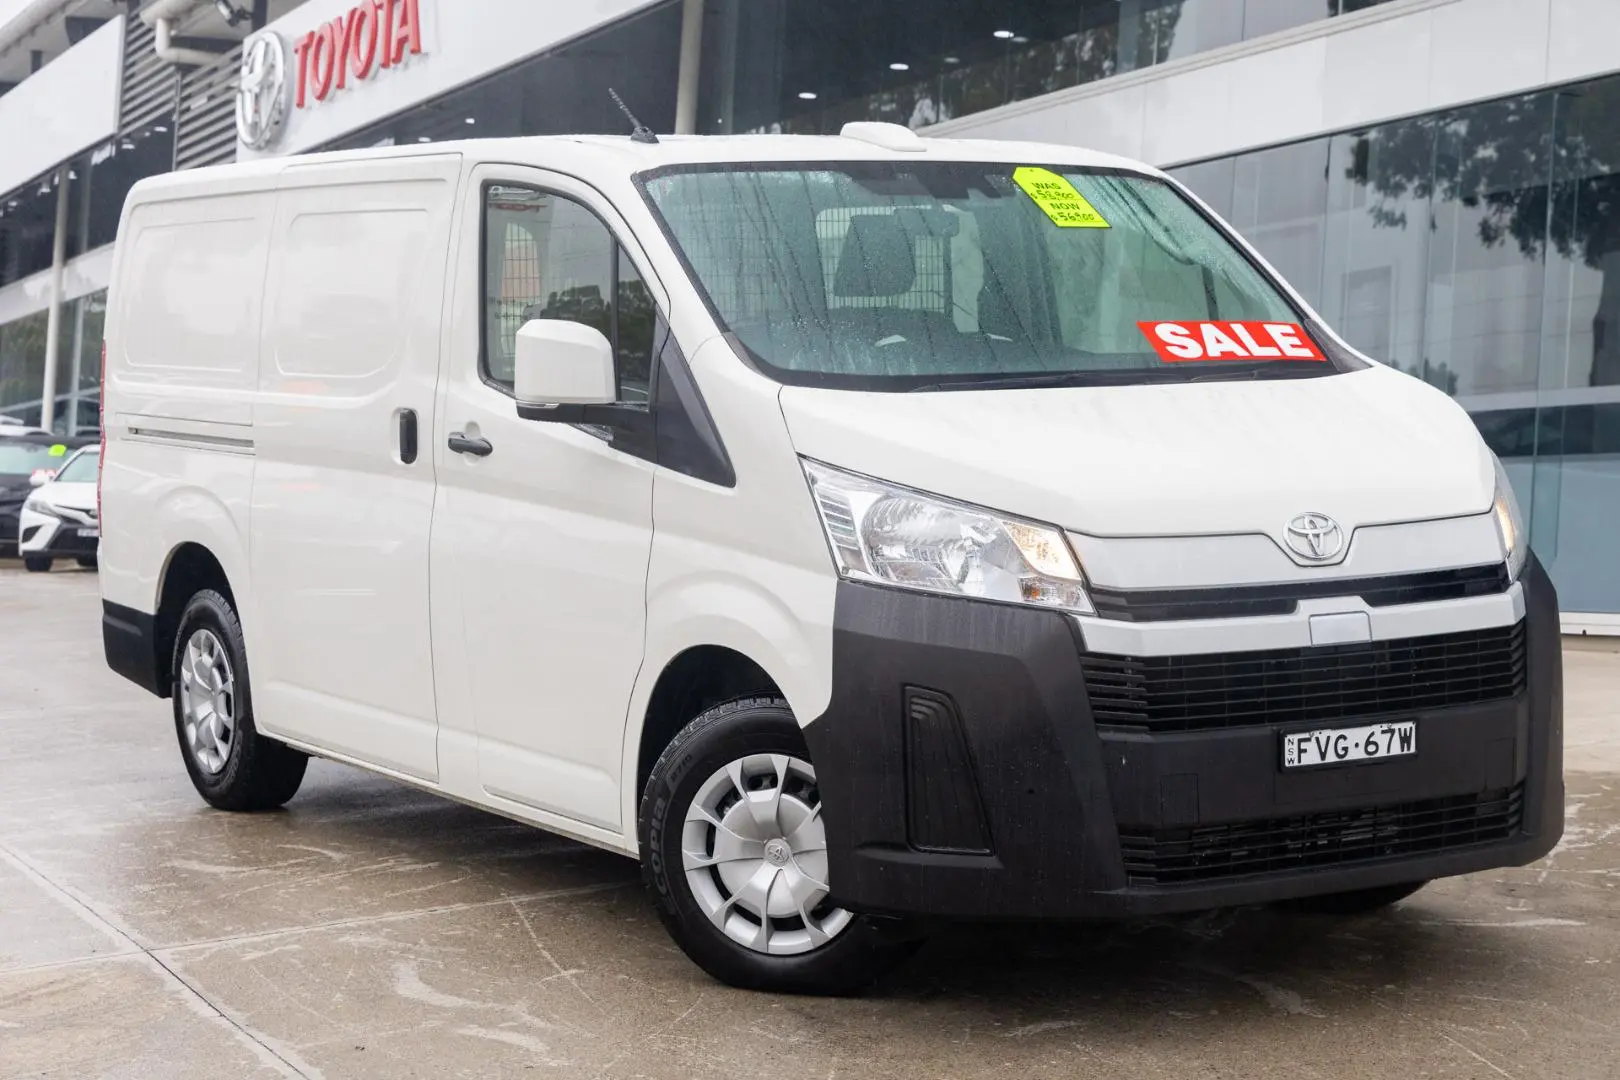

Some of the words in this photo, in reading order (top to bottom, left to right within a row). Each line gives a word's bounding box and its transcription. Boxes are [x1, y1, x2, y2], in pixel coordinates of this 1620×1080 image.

[294, 0, 422, 108] TOYOTA
[1049, 202, 1080, 210] NOW
[1154, 322, 1315, 358] SALE
[1287, 738, 1295, 765] NSW
